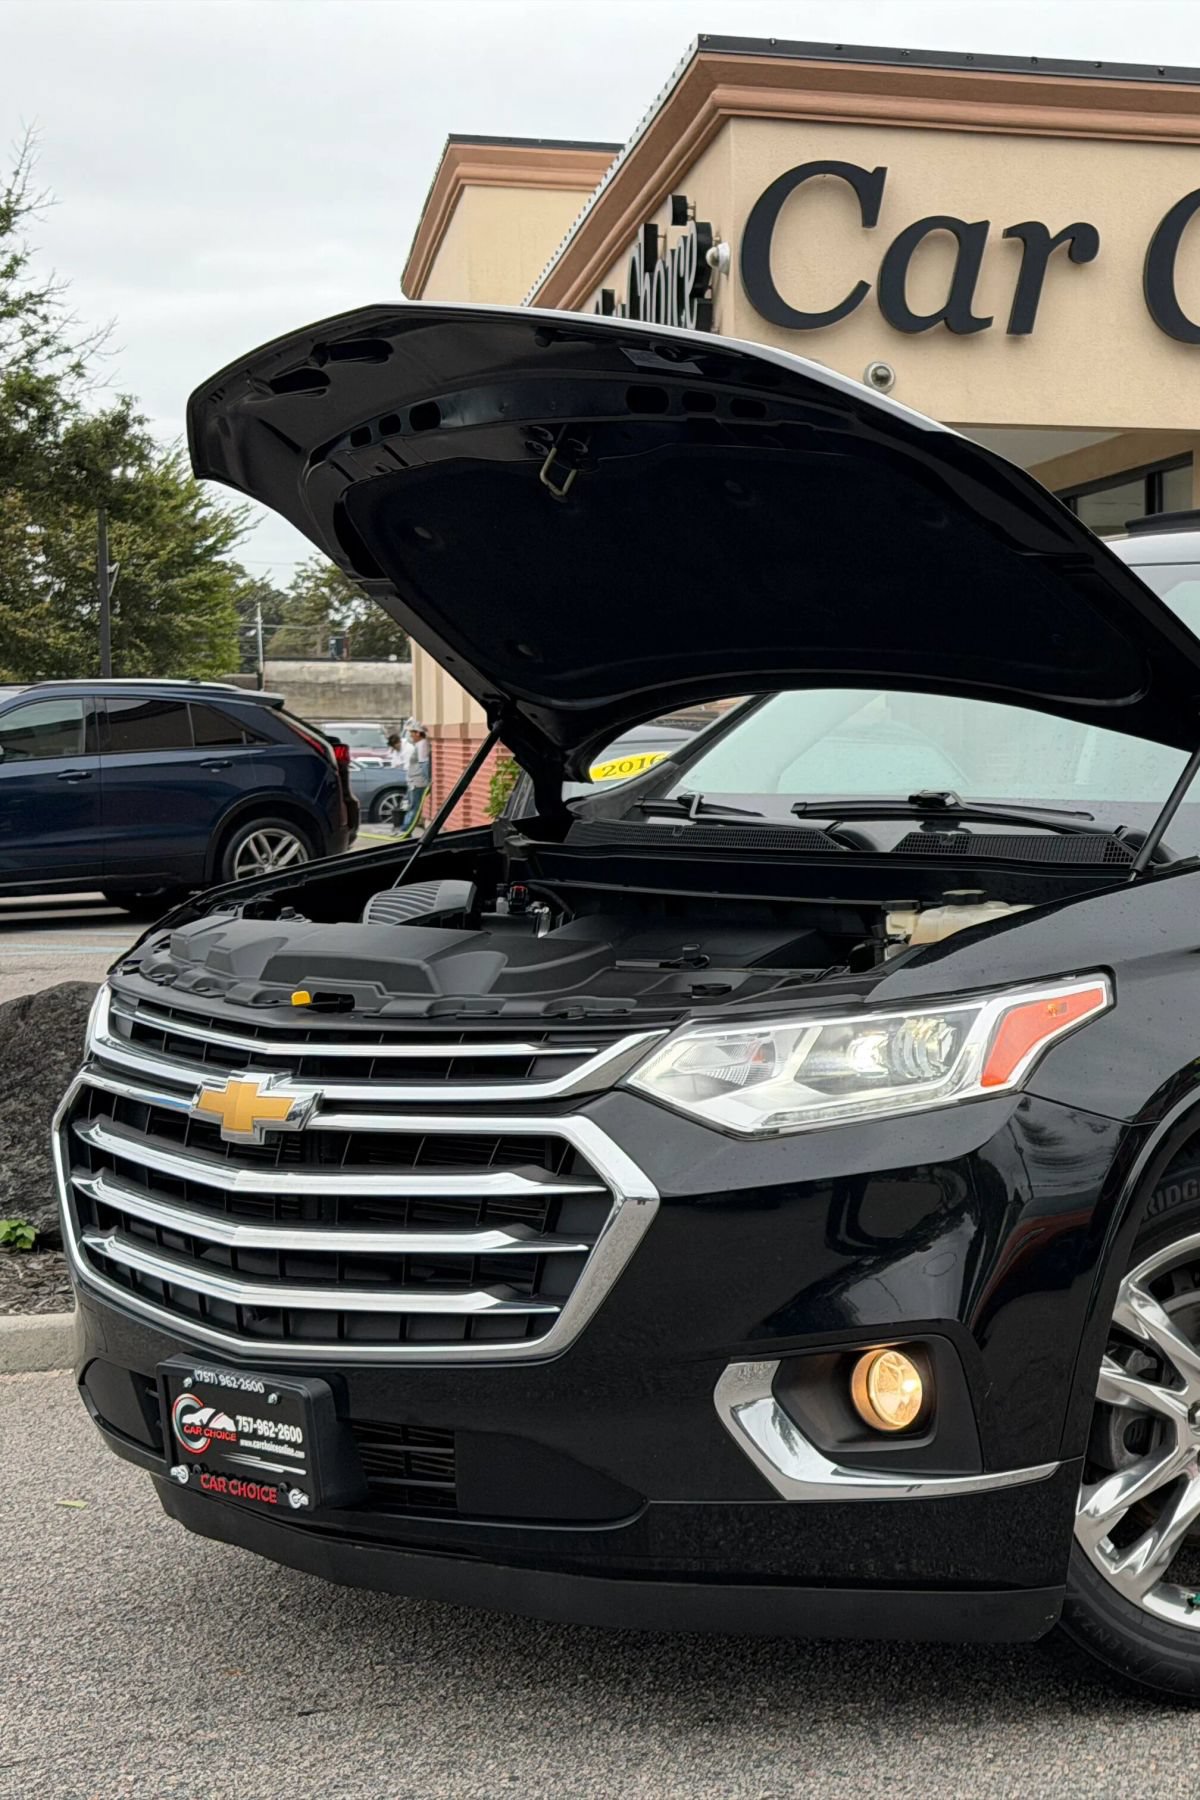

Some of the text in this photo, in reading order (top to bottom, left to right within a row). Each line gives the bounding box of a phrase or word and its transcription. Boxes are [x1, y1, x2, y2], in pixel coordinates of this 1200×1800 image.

[741, 159, 1100, 336] Car
[218, 1374, 265, 1394] 962-2600
[183, 1424, 237, 1442] CAR CHOICE
[236, 1414, 303, 1444] 757-962-2600
[200, 1473, 278, 1504] CAR CHOICE
